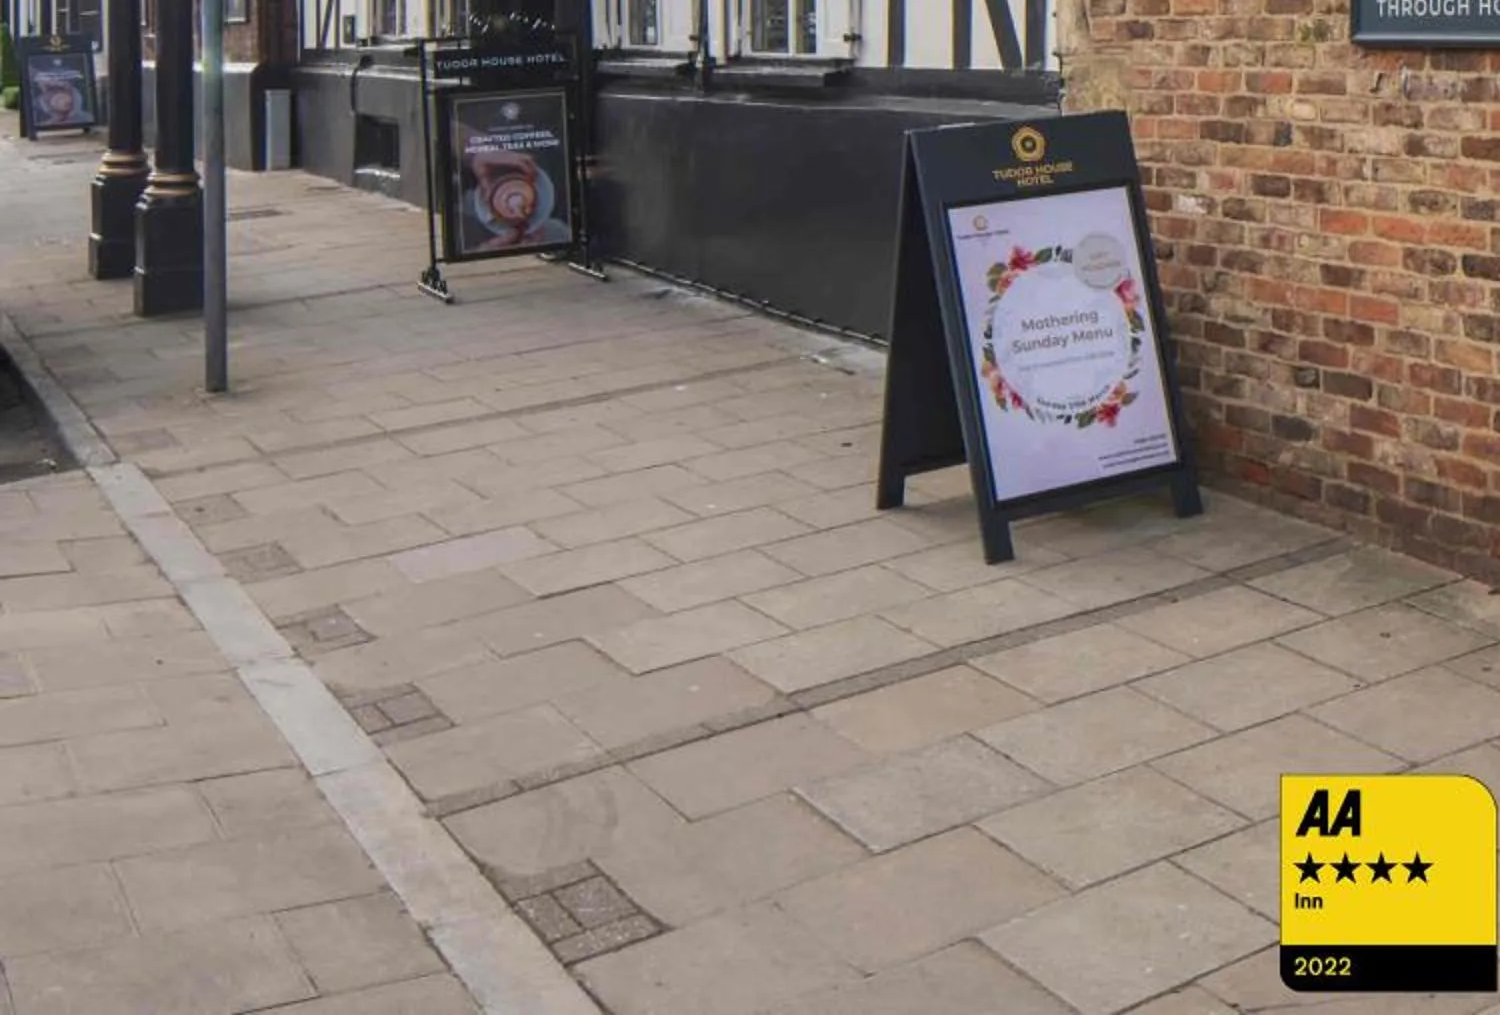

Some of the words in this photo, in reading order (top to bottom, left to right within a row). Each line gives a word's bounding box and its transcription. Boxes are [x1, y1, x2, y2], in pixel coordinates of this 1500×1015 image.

[436, 58, 478, 70] TUDOR
[481, 55, 523, 67] HOUSE
[527, 51, 566, 64] HOTEL
[992, 166, 1034, 181] TUDOR
[1036, 160, 1073, 175] HOUSE
[1017, 174, 1055, 187] HOTEL
[1020, 310, 1099, 332] Mothering
[1012, 333, 1069, 354] Sunday
[1073, 327, 1113, 344] Menu
